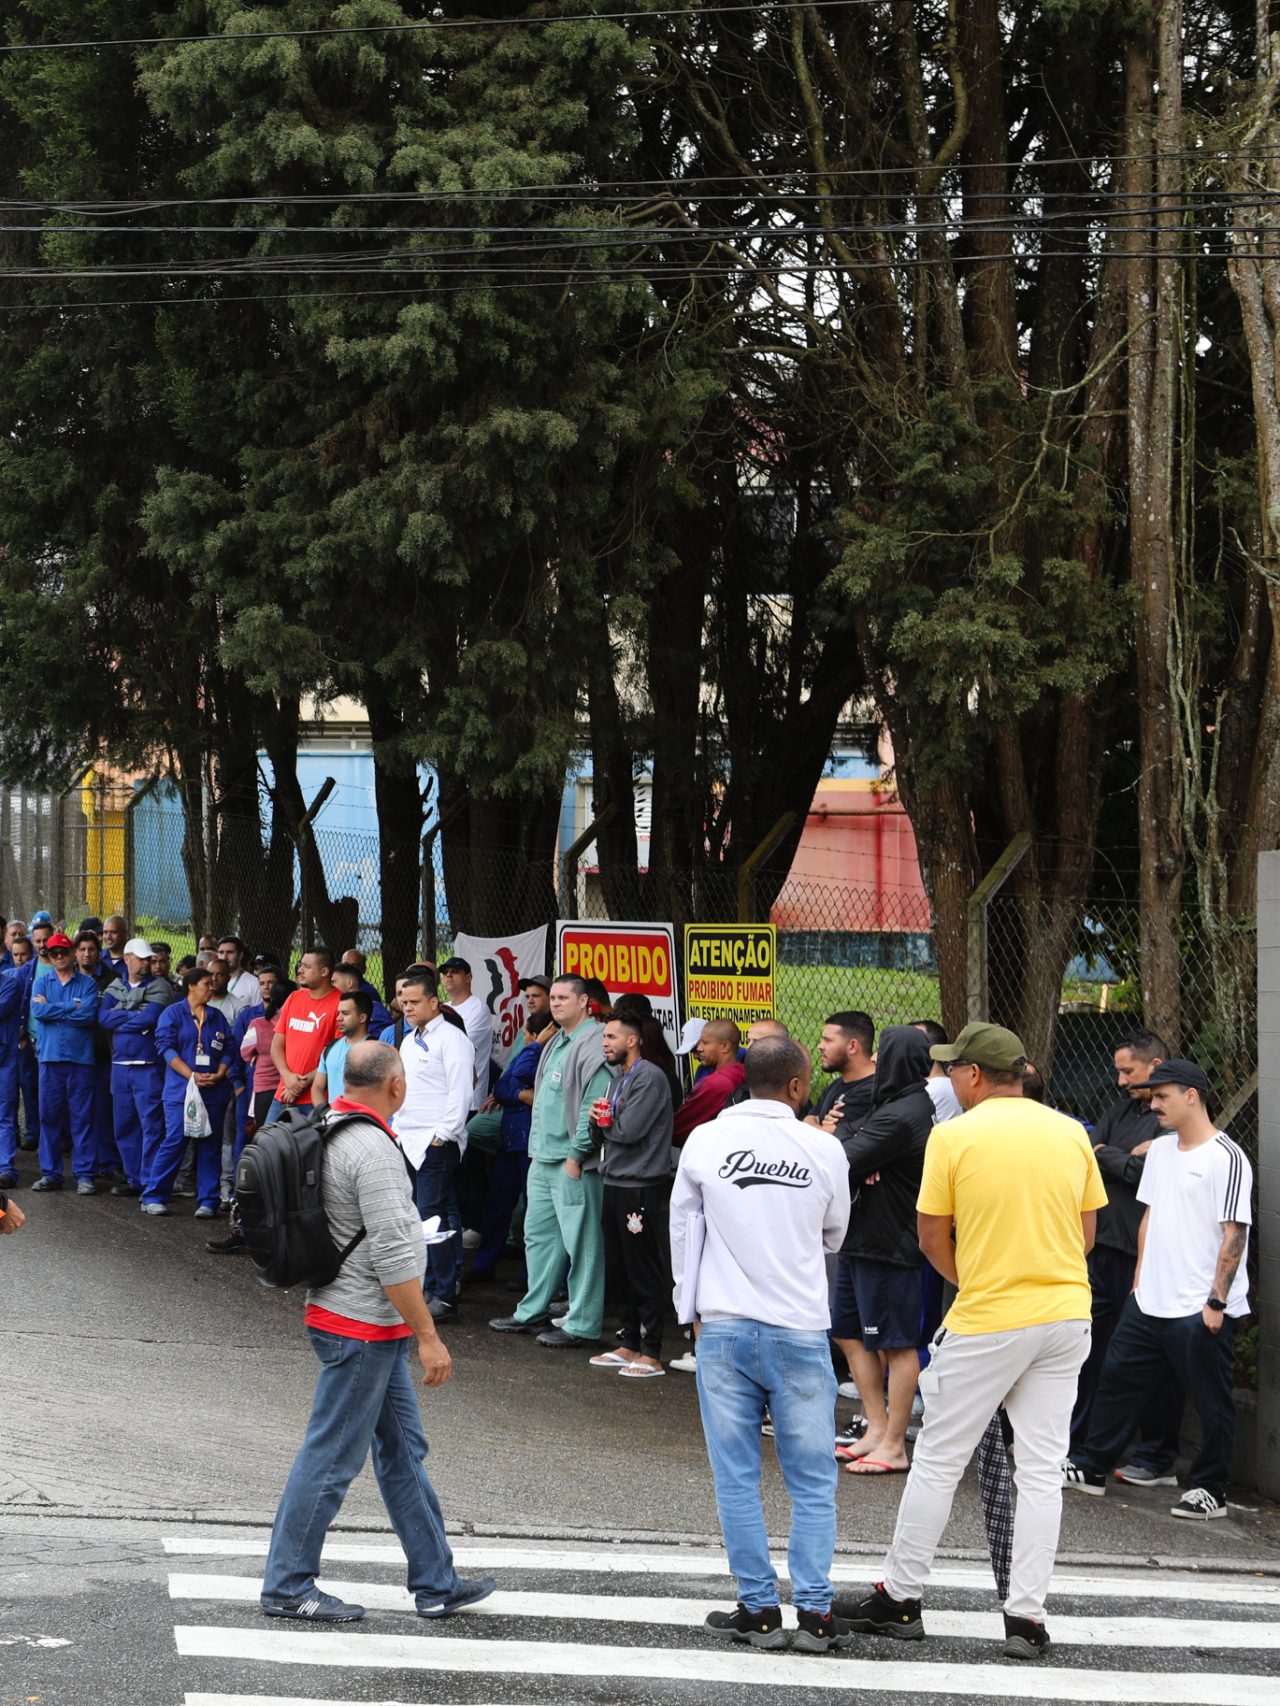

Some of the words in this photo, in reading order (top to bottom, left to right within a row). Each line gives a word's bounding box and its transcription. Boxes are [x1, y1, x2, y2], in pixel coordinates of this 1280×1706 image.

[565, 942, 667, 986] PROIBIDO
[689, 933, 770, 975] ATENÇÃO
[689, 980, 733, 1001] PROIBIDO
[737, 982, 771, 1002] FUMAR
[288, 1017, 315, 1033] PUMA
[690, 1005, 700, 1019] NO
[702, 1006, 772, 1023] ESTACIONAMENTO
[718, 1149, 812, 1181] Puebla
